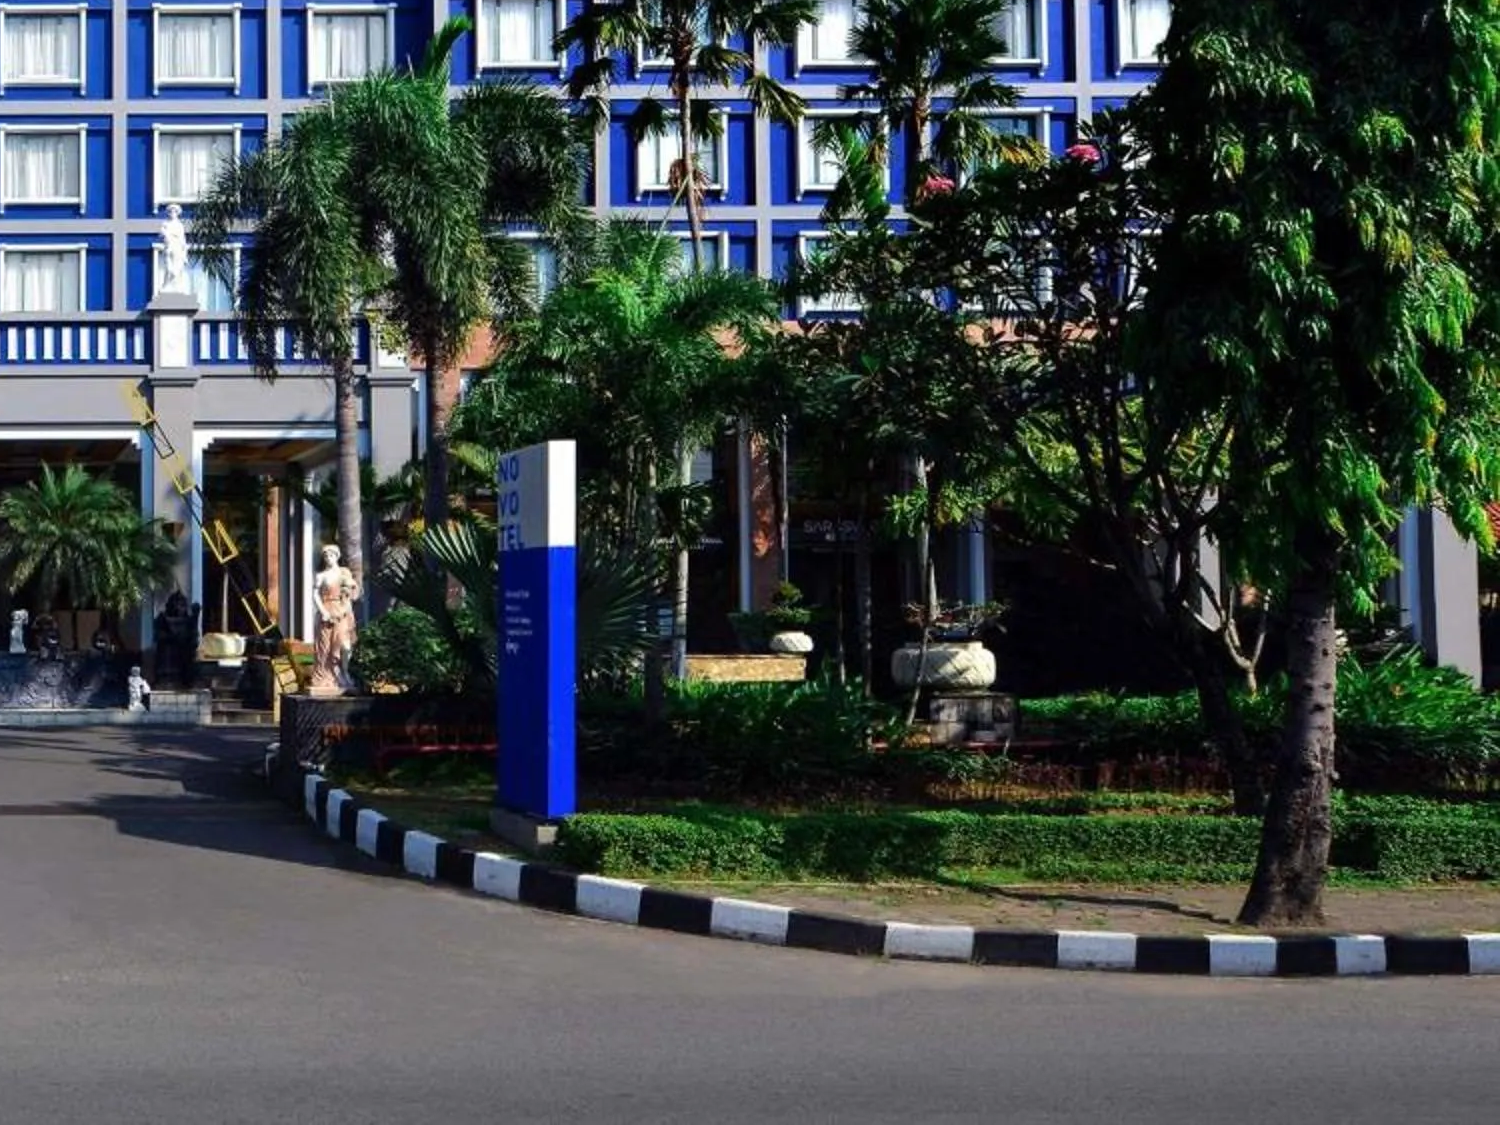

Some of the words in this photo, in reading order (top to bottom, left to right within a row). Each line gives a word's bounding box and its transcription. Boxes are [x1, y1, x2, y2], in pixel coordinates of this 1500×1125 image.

[499, 455, 520, 483] NO
[499, 491, 519, 516] VO
[499, 524, 525, 551] TEL
